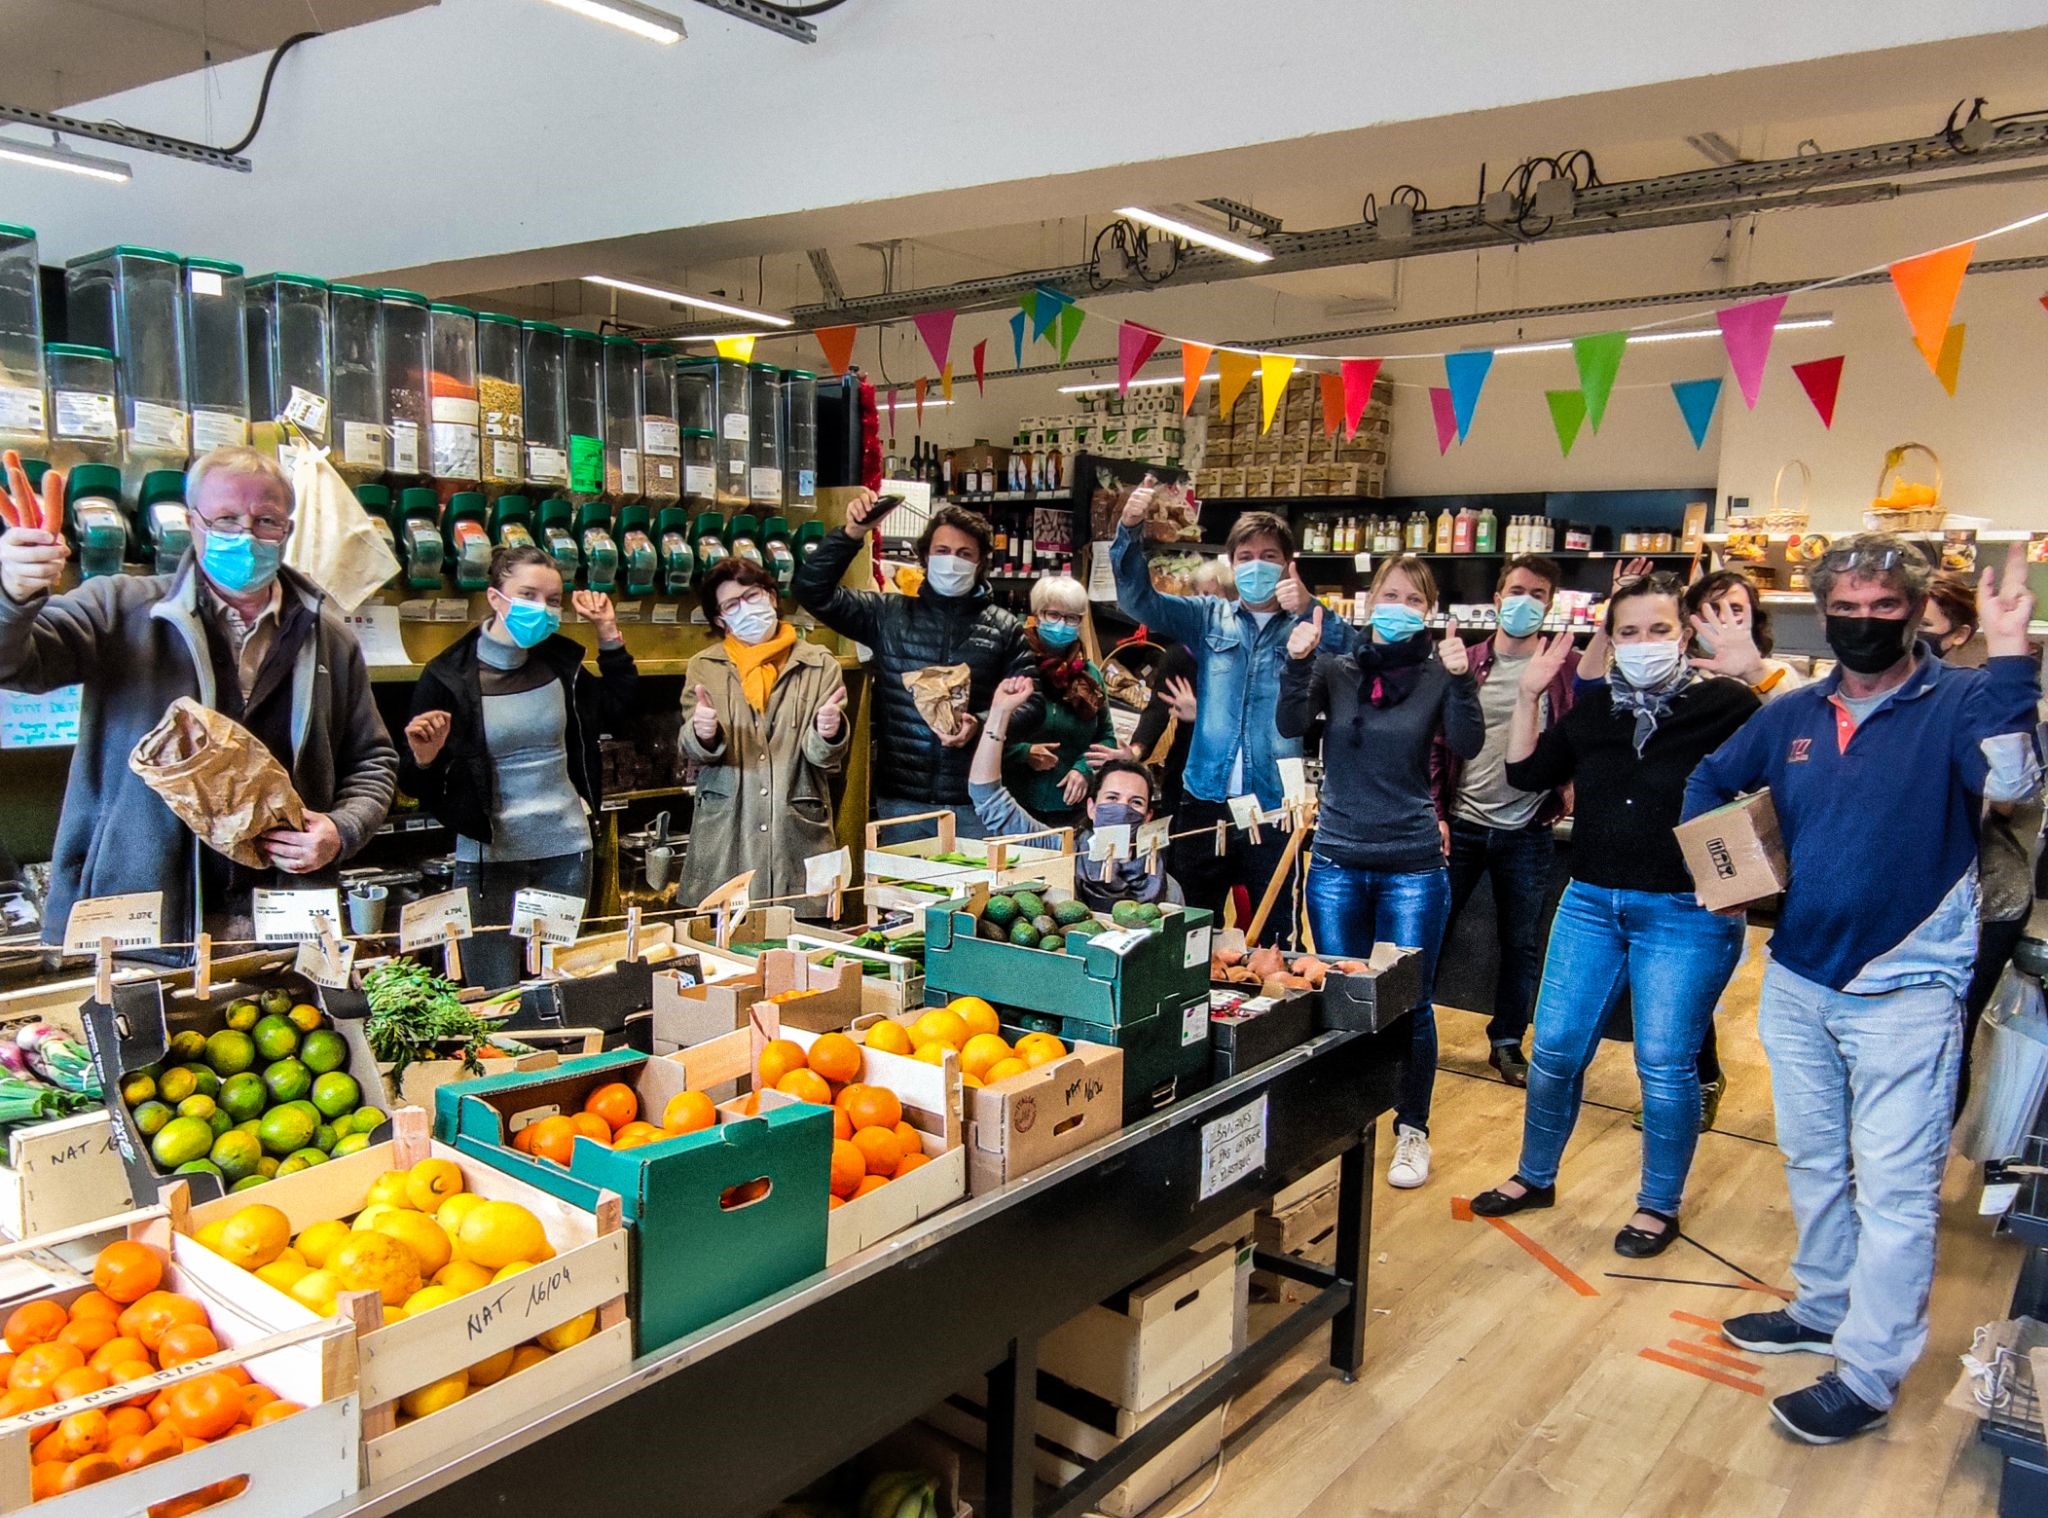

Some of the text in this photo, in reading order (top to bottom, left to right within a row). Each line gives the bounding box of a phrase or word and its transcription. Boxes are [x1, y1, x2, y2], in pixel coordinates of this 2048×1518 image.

[51, 1139, 92, 1166] NAT
[467, 1265, 572, 1341] NAT 16/04
[18, 1403, 68, 1423] PRO
[83, 1385, 129, 1404] NAT
